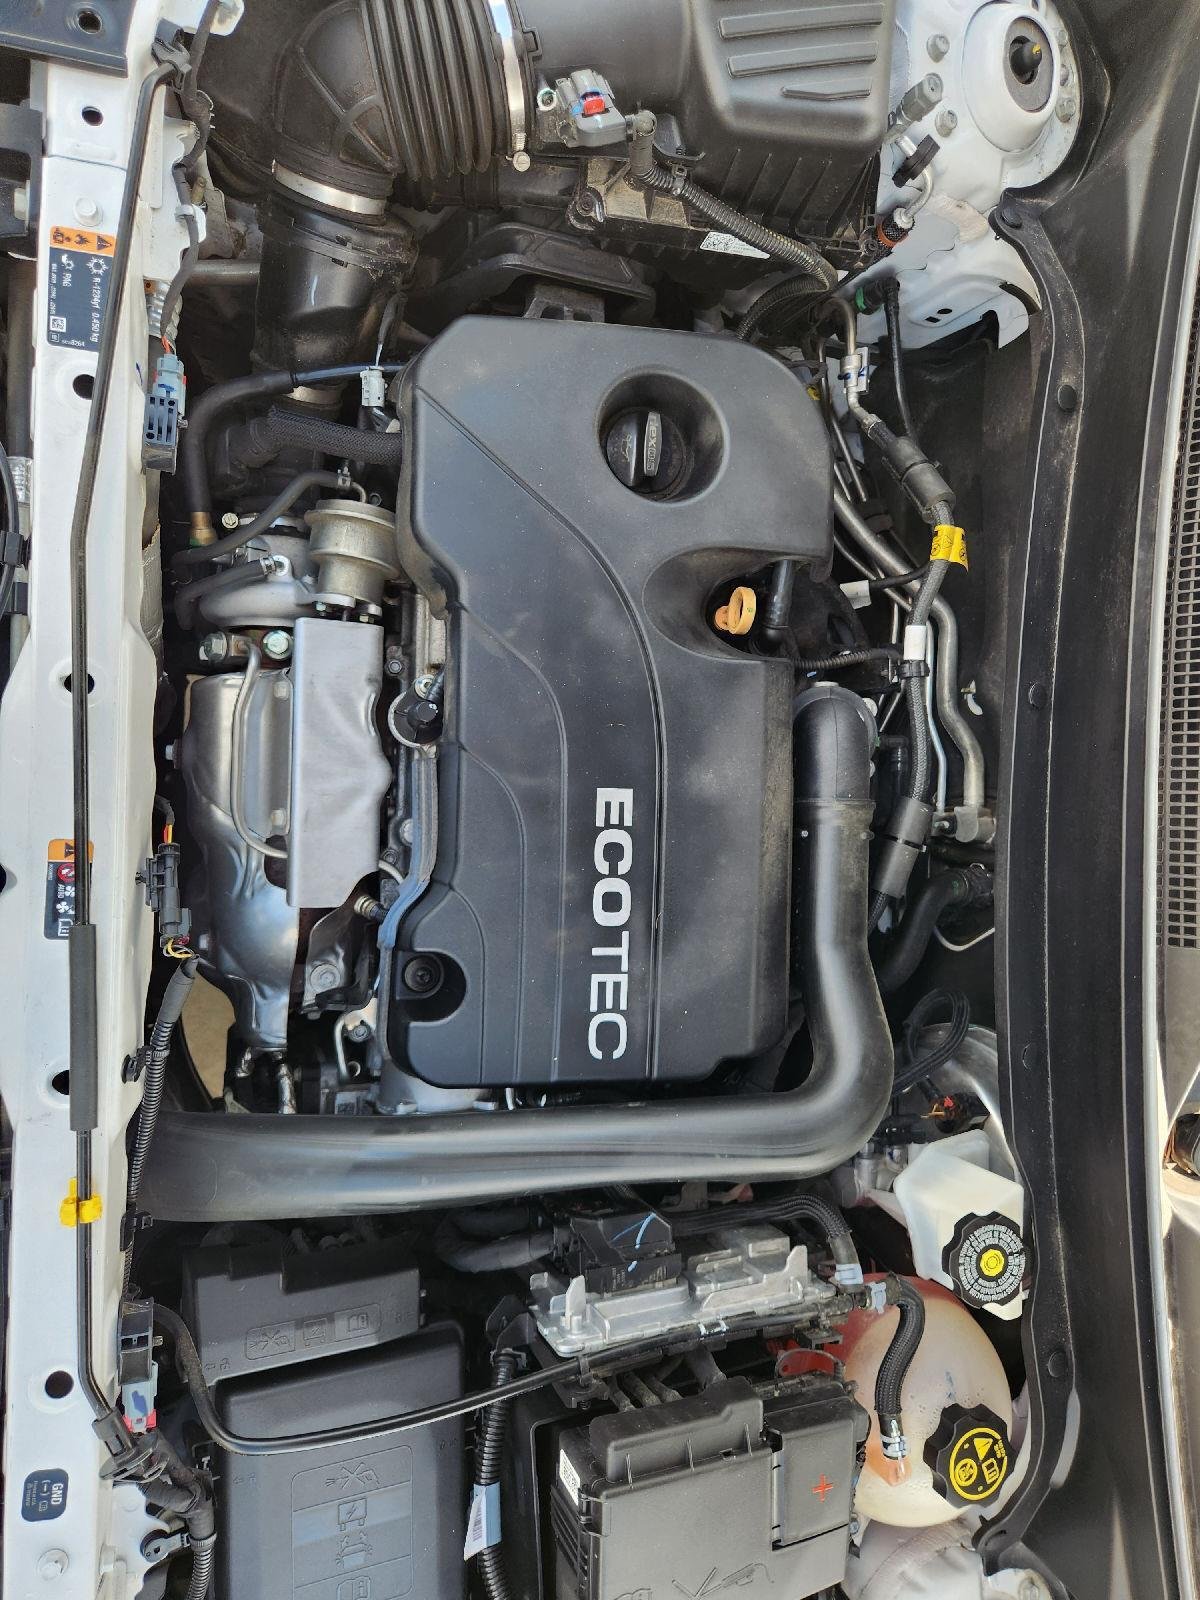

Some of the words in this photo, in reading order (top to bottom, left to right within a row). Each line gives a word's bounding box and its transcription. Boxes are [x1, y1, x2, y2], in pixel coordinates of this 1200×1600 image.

[62, 272, 72, 287] PAG
[89, 333, 99, 343] kg
[588, 787, 634, 1060] ECOTEC
[51, 1483, 63, 1505] GND
